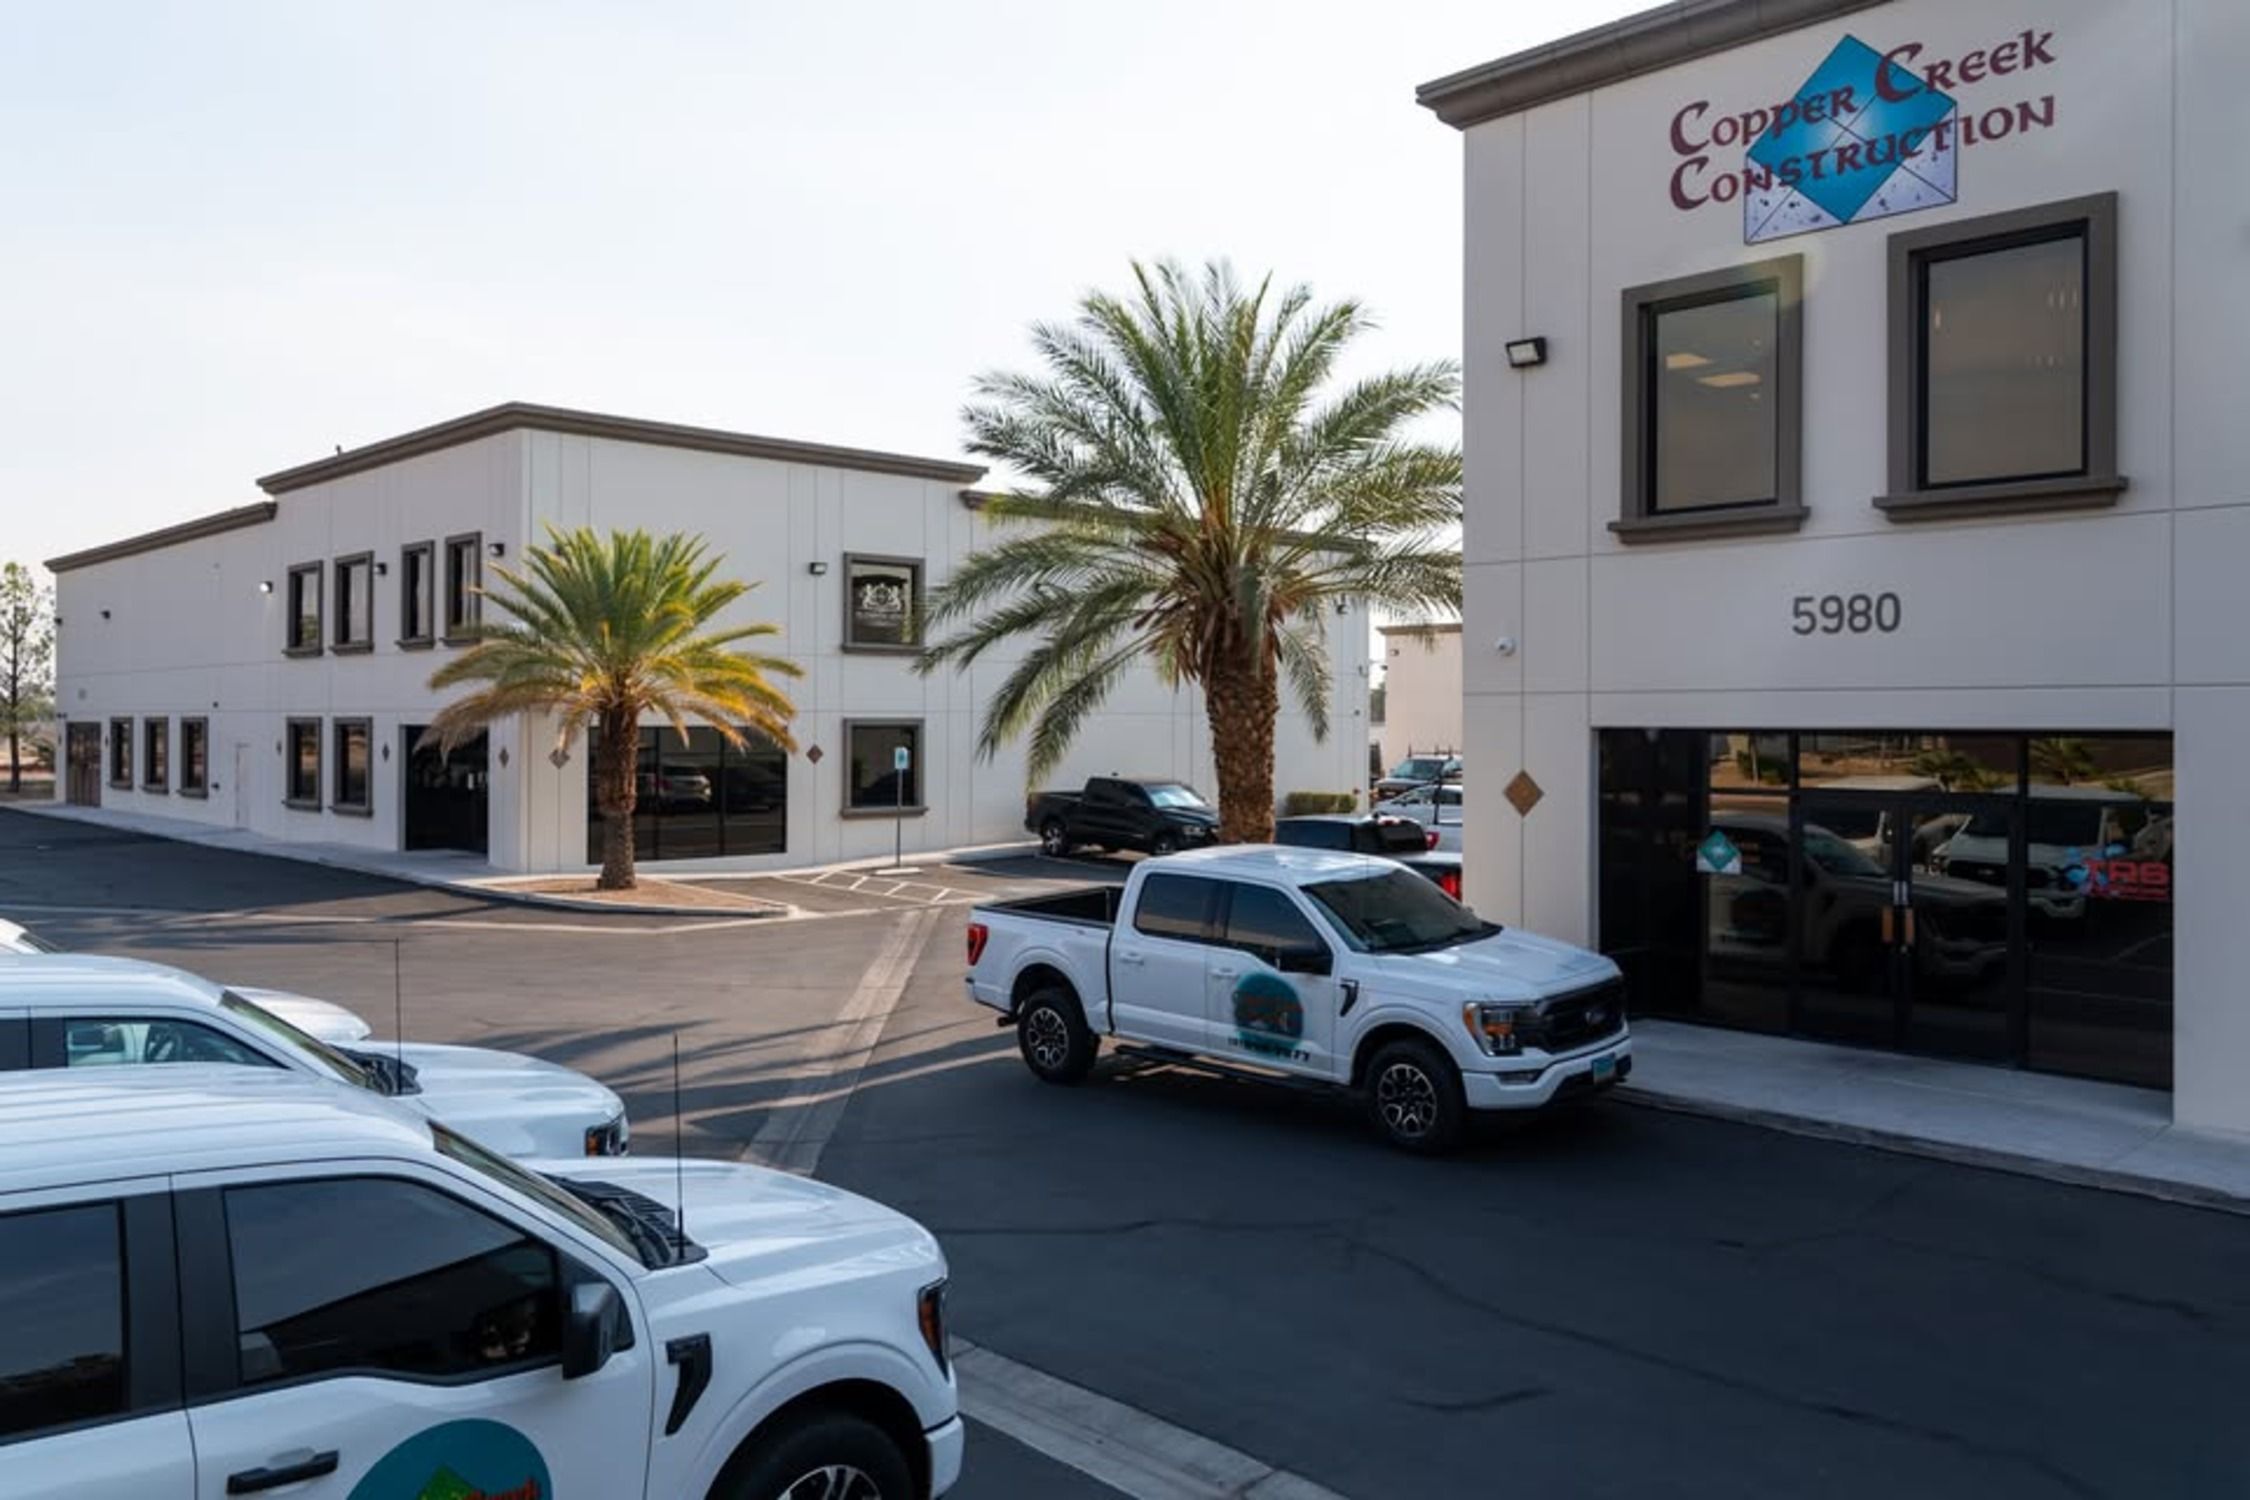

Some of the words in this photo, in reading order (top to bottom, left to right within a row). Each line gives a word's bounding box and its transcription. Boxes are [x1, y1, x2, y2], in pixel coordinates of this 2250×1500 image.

[1670, 85, 1859, 156] COPPER
[1875, 29, 2057, 103] CREEK
[1670, 95, 2056, 211] CONSTRUCTION
[1792, 592, 1901, 636] 5980
